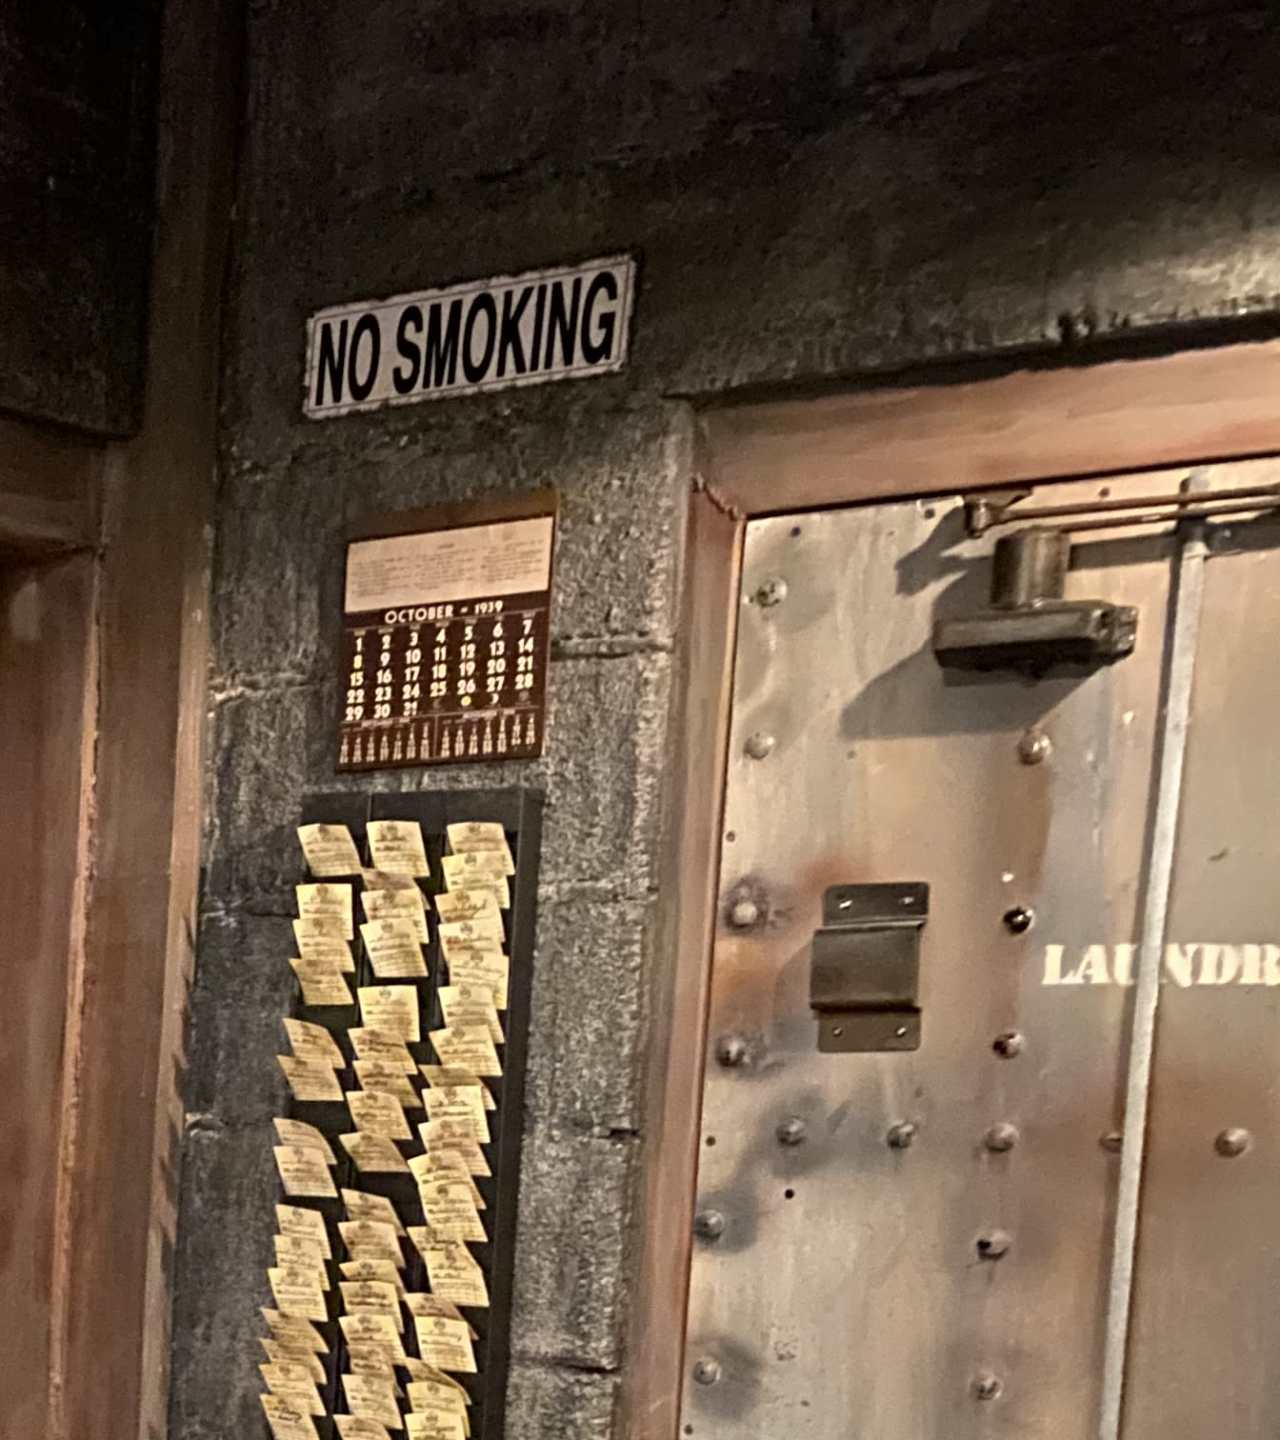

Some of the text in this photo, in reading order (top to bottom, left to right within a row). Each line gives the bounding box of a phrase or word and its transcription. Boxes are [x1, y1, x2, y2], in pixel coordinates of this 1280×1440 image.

[314, 271, 619, 406] NO SMOKING
[384, 605, 454, 624] OCTOBER
[473, 601, 504, 615] 1939
[356, 619, 533, 652] 1 2 3 4 5 6 7
[353, 637, 534, 669] 8 9 10 11 12 13 14
[350, 656, 533, 686] 15 16 17 18 19 20 21
[347, 673, 534, 704] 22 23 24 25 26 27 28
[345, 701, 418, 721] 29 30 31
